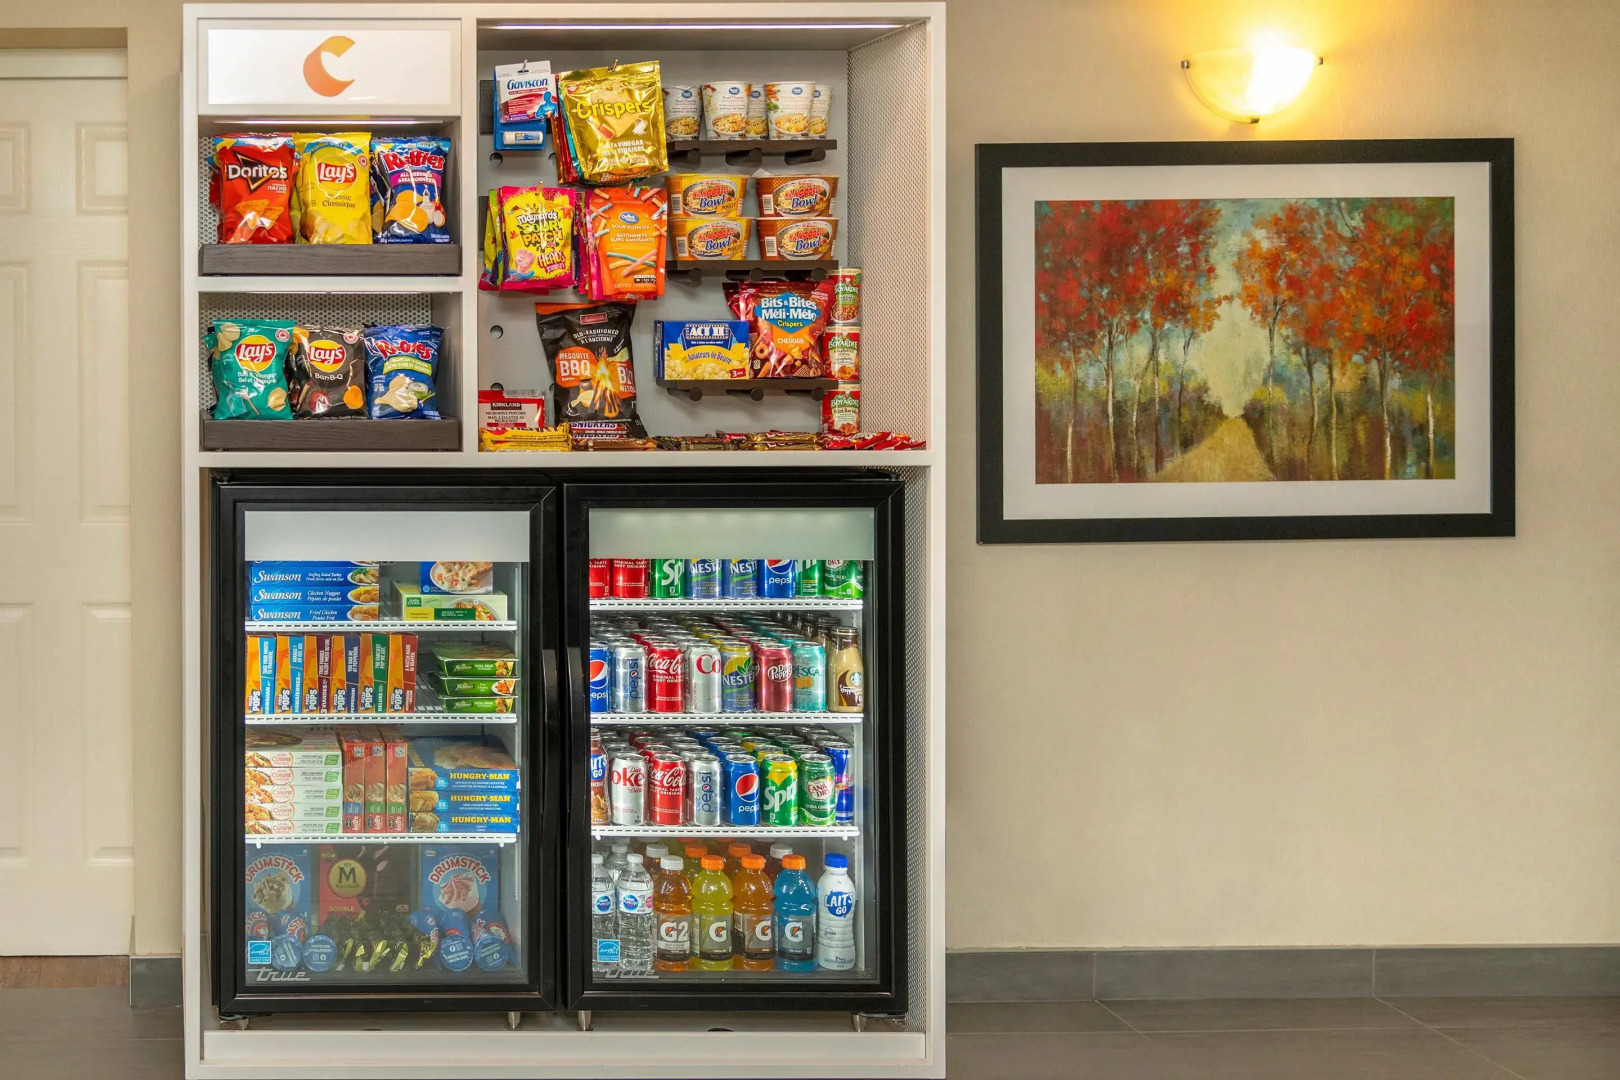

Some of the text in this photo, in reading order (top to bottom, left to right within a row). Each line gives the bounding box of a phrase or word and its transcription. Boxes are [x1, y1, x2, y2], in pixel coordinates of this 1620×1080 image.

[507, 79, 548, 91] Gaviscon
[577, 101, 652, 120] Crispers
[383, 149, 445, 173] Ruffles
[228, 165, 288, 180] Doritos
[319, 162, 356, 184] Lay's
[322, 199, 356, 209] Classique
[700, 194, 726, 208] Bowl
[791, 194, 818, 209] Bowl
[705, 236, 731, 251] Bowl
[796, 236, 821, 251] Bowl
[761, 298, 783, 308] Bits
[789, 296, 818, 310] Bites
[689, 327, 725, 336] ACT II
[777, 320, 803, 329] Crispers
[573, 329, 619, 339] OLD-FASHIONED
[239, 344, 274, 364] Lay's
[310, 347, 343, 365] Lay's
[560, 360, 592, 378] BBQ
[254, 571, 302, 584] Swanson
[254, 589, 302, 602] Swanson
[253, 609, 302, 621] Swanson
[696, 654, 722, 675] Co
[252, 690, 261, 712] POPS
[282, 689, 290, 711] POPS
[309, 689, 318, 711] POPS
[337, 690, 346, 711] POPS
[365, 687, 373, 709] POPS
[394, 689, 403, 710] POPS
[590, 692, 608, 700] eps
[592, 769, 603, 778] GO
[611, 767, 645, 787] oke
[337, 867, 359, 884] M
[429, 856, 492, 885] DRUMSTICK
[835, 906, 847, 915] GO
[709, 921, 727, 942] G
[755, 920, 772, 941] G
[785, 922, 803, 942] G
